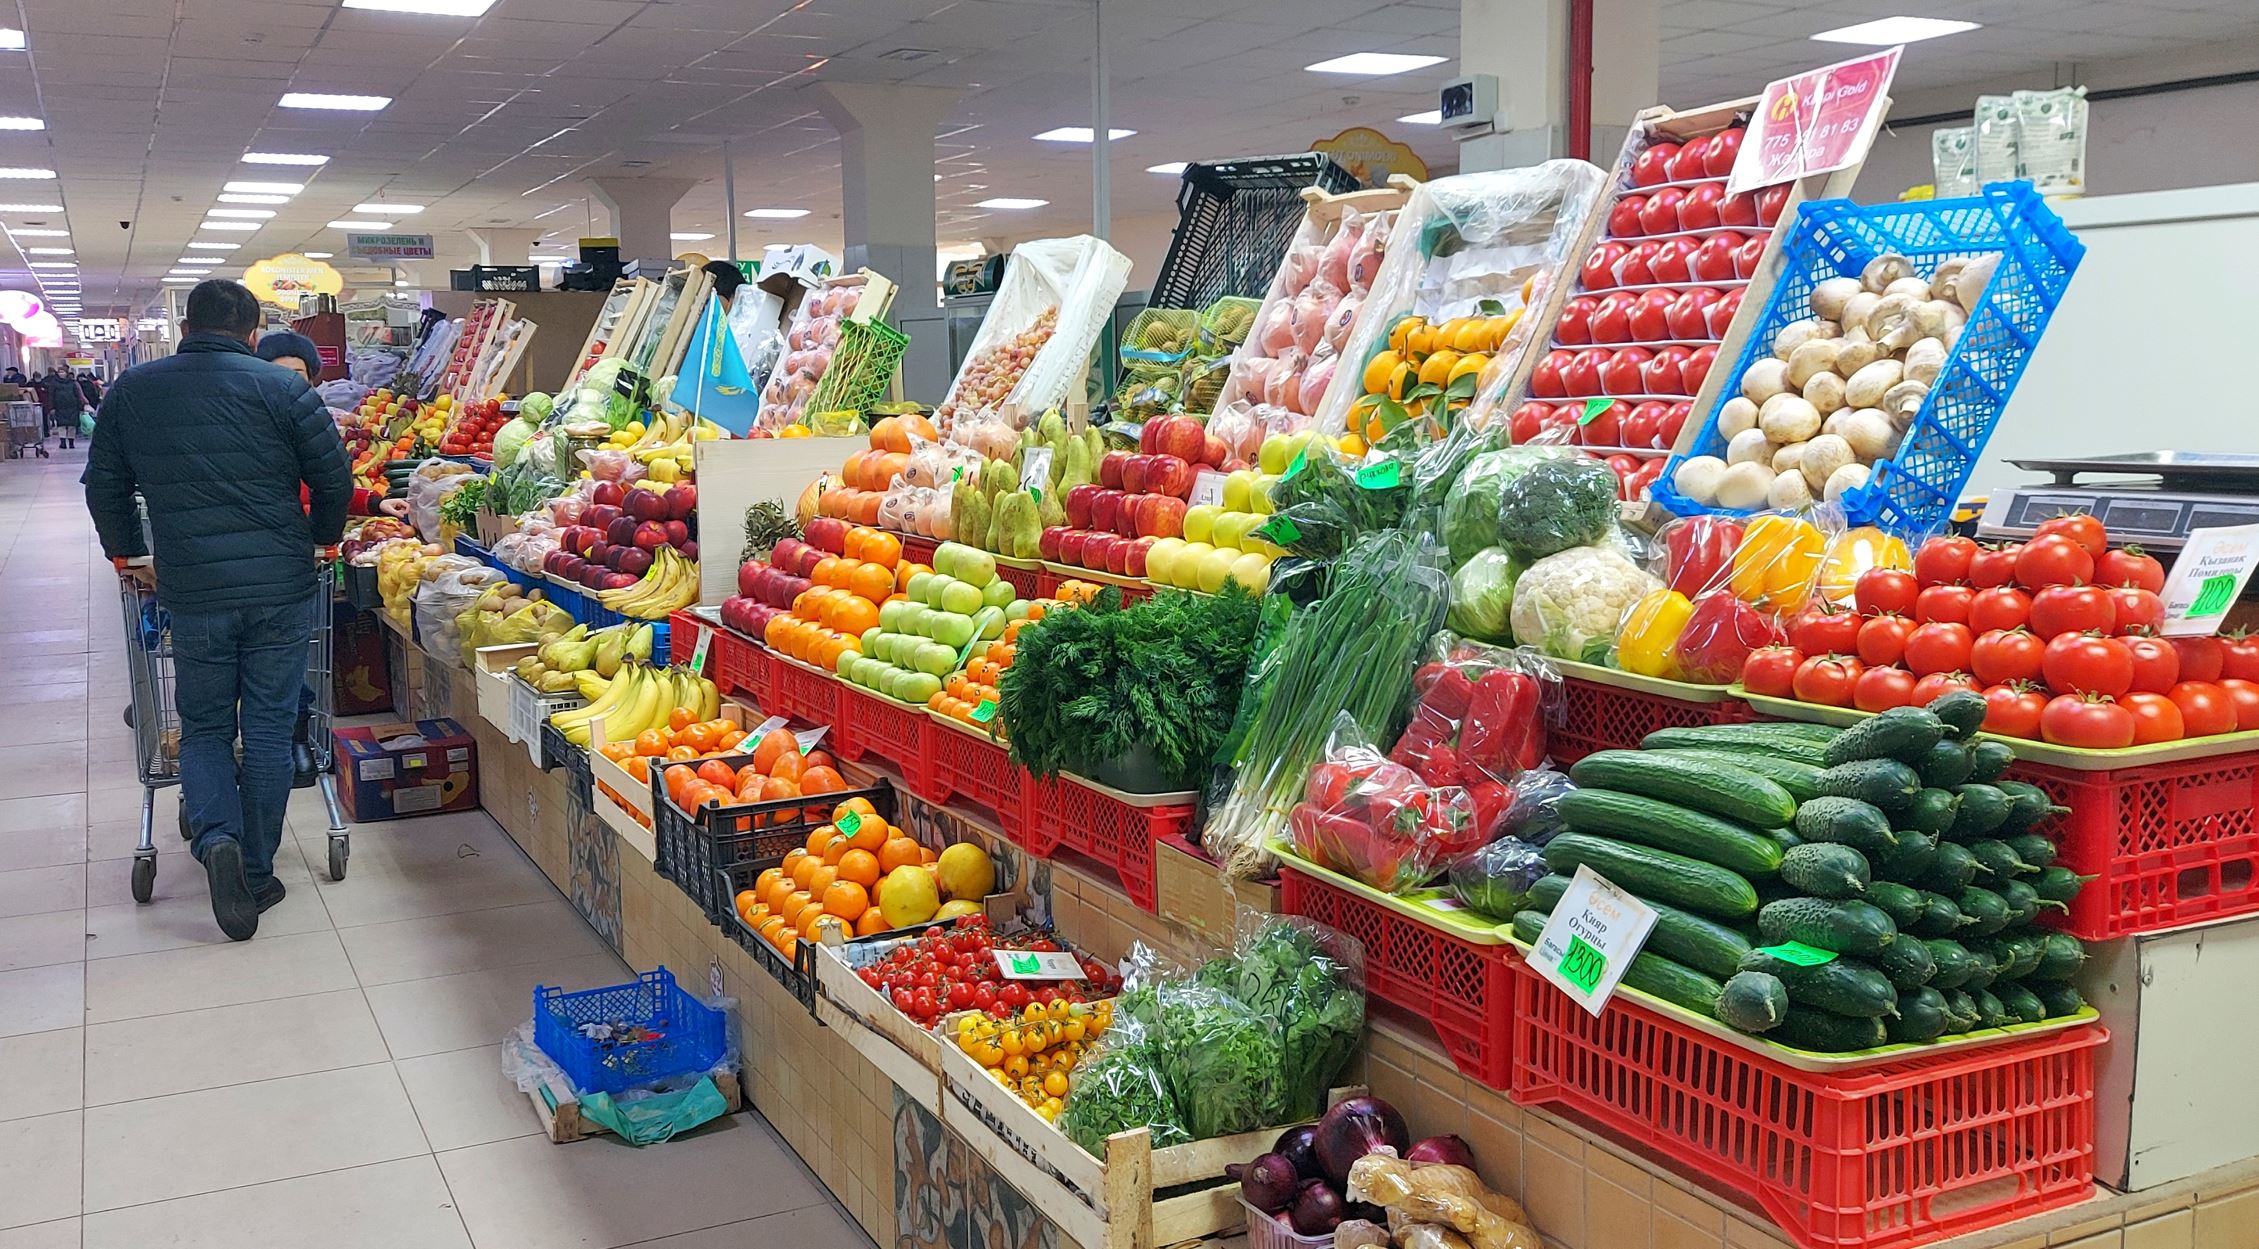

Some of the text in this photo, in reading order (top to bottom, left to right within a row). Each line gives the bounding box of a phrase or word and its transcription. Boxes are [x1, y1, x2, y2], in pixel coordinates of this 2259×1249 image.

[1838, 81, 1867, 98] Gold
[1765, 133, 1791, 151] 775
[1820, 124, 1838, 138] 81
[1841, 118, 1859, 133] 83
[357, 236, 416, 246] МИКРОЗЕЛЕНЬ
[403, 247, 431, 256] ЦВЕТЫ
[1568, 917, 1607, 950] Огурцы
[1564, 941, 1603, 987] 1300
